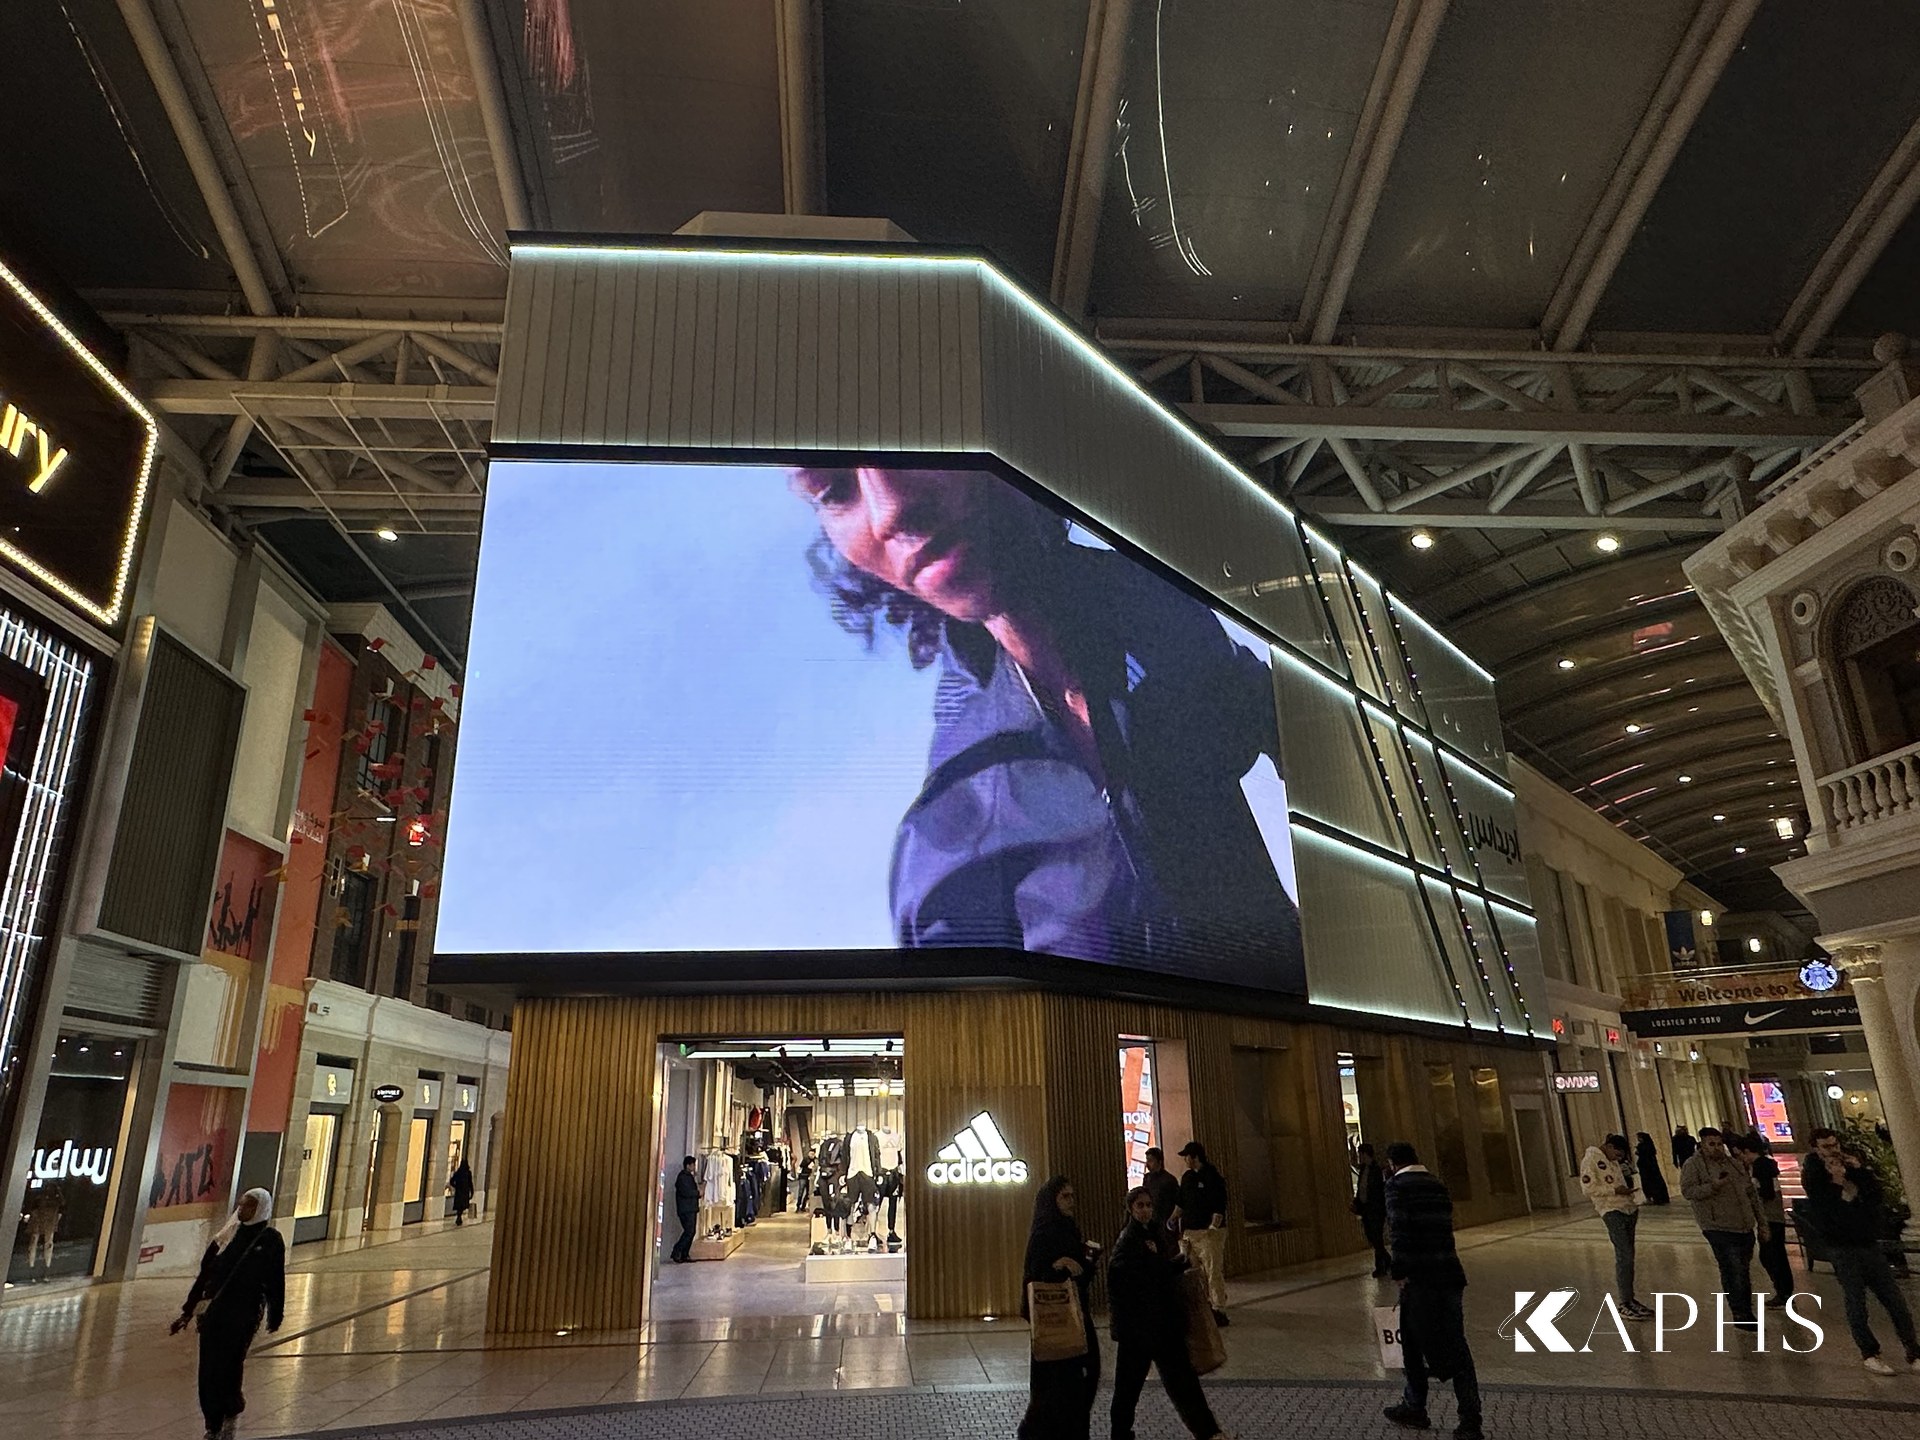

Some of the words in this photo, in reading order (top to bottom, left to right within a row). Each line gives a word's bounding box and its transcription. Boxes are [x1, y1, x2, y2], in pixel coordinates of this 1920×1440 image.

[1678, 984, 1763, 1002] Welcome
[1768, 983, 1789, 997] to
[1651, 1018, 1685, 1028] LOCATED
[1688, 1017, 1697, 1025] AT
[926, 1157, 1028, 1184] adidas
